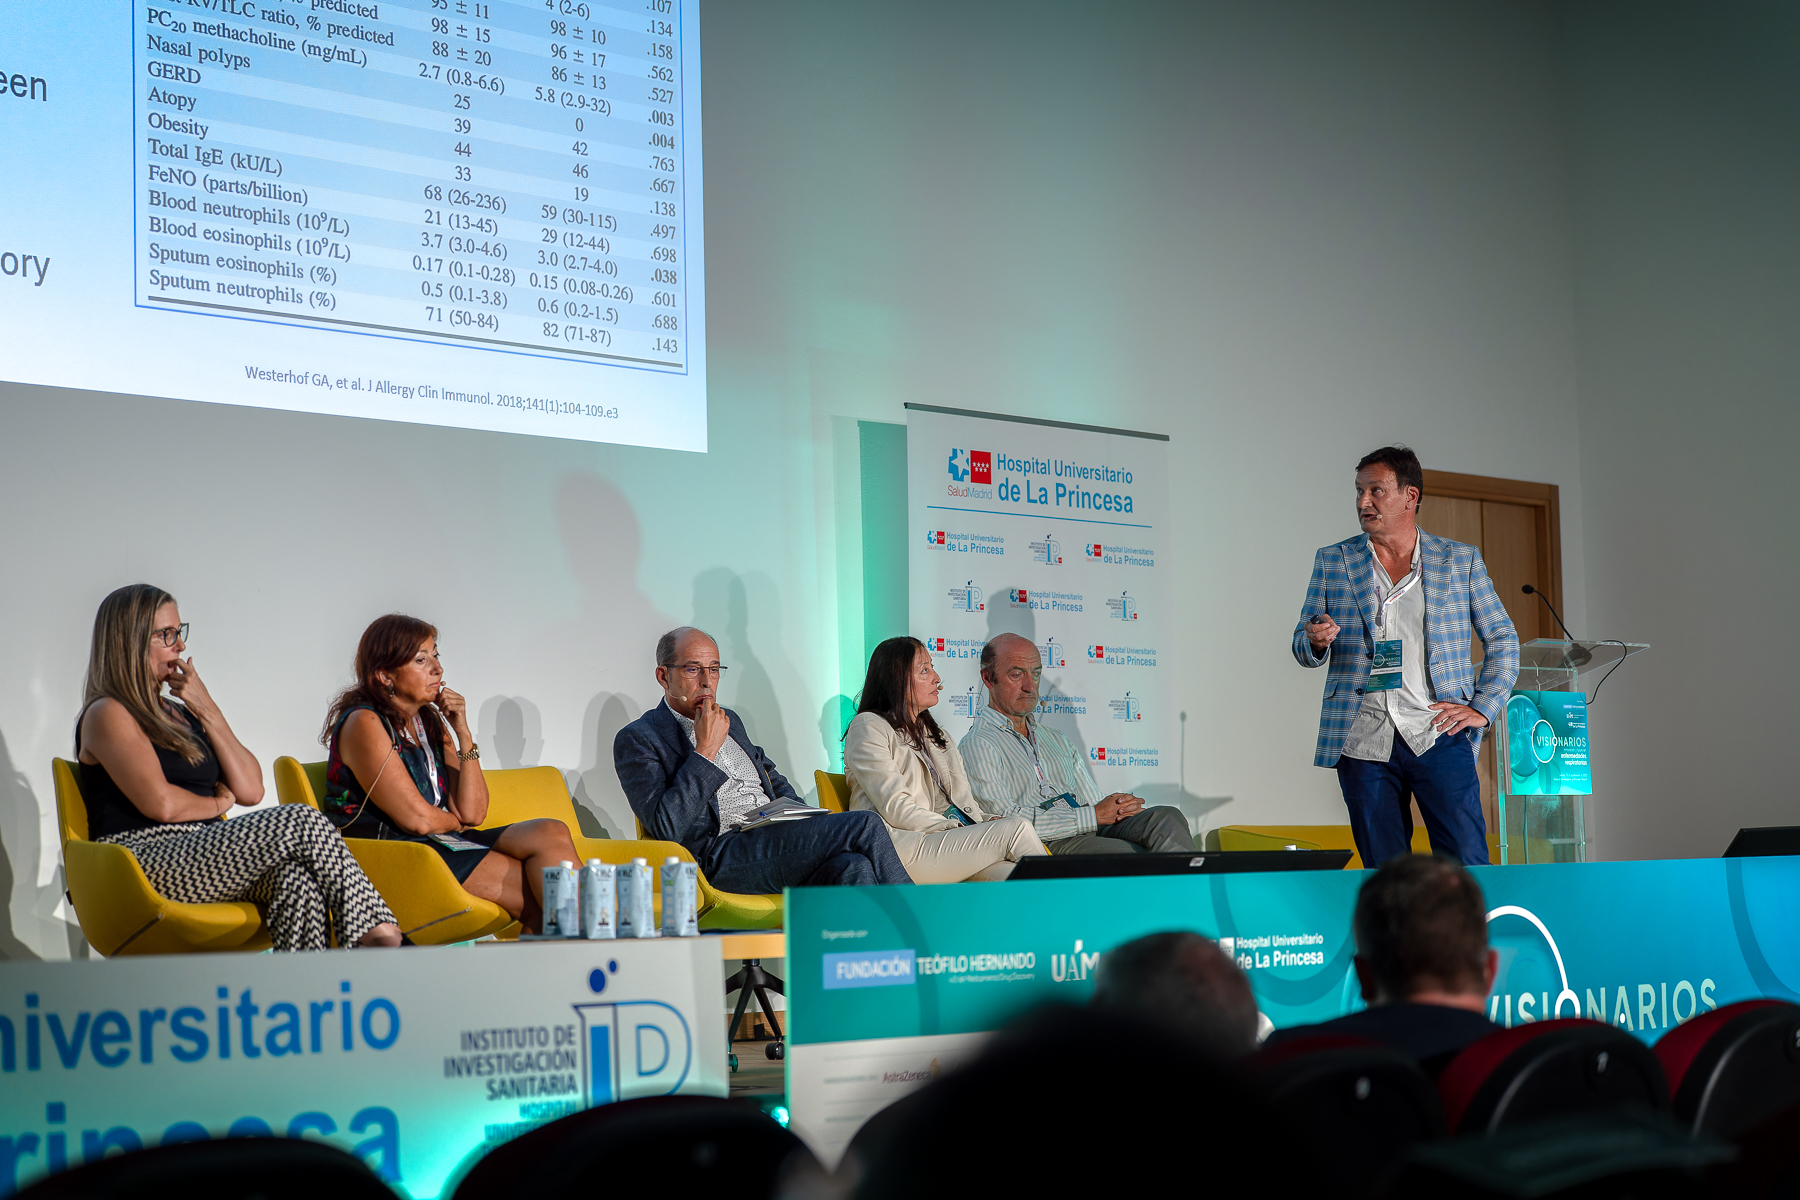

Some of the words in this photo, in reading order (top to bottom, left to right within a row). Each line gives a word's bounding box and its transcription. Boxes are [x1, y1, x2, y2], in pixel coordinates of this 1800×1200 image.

[311, 0, 379, 20] predicted
[475, 3, 489, 19] 11
[559, 0, 590, 21] (2-6)
[646, 0, 672, 14] .107
[261, 9, 300, 30] ratio,
[306, 15, 321, 31] %
[327, 23, 395, 47] predicted
[431, 17, 448, 35] 98
[476, 27, 490, 43] 15
[550, 19, 566, 36] 98
[592, 29, 606, 45] 10
[647, 20, 673, 37] .134
[146, 33, 192, 57] Nasal
[198, 48, 250, 71] polyps
[192, 21, 296, 52] methacholine
[301, 39, 367, 68] (mg/mL)
[432, 40, 449, 58] 88
[474, 50, 491, 66] 20
[647, 43, 673, 60] .158
[551, 43, 567, 60] 96
[592, 52, 606, 68] 17
[147, 61, 201, 84] GERD
[419, 62, 441, 80] 2.7
[446, 68, 505, 96] (0.8-6.6)
[551, 65, 568, 82] 86
[592, 75, 606, 90] 13
[647, 65, 674, 83] .562
[147, 86, 197, 112] Atopy
[454, 93, 470, 110] 25
[535, 86, 555, 103] 5.8
[561, 92, 611, 117] (2.9-32)
[648, 87, 674, 104] .527
[148, 112, 209, 140] Obesity
[454, 118, 471, 134] 39
[575, 117, 584, 132] 0
[648, 109, 674, 127] .003
[454, 141, 472, 157] 44
[572, 141, 588, 156] 42
[648, 132, 675, 150] .004
[147, 137, 189, 160] Total
[195, 145, 224, 167] IgE
[230, 152, 282, 178] (kU/L)
[649, 155, 675, 172] .763
[455, 165, 471, 182] 33
[572, 163, 589, 179] 46
[148, 164, 197, 187] FeNO
[203, 174, 308, 207] (parts/billion)
[575, 187, 589, 202] 19
[649, 177, 675, 194] .667
[148, 189, 197, 212] Blood
[203, 202, 291, 226] neutrophils
[424, 184, 442, 201] 68
[448, 188, 507, 215] (26-236)
[650, 201, 676, 217] .138
[424, 209, 441, 225] 21
[448, 213, 498, 237] (13-45)
[541, 204, 557, 220] 59
[562, 208, 617, 233] (30-115)
[148, 215, 197, 238] Blood
[203, 227, 292, 252] eosinophils
[541, 228, 558, 244] 29
[563, 232, 610, 255] (12-44)
[650, 223, 676, 240] .497
[421, 231, 443, 249] 3.7
[449, 236, 508, 262] (3.0-4.6)
[650, 246, 677, 263] .698
[0, 252, 51, 287] ory
[149, 242, 211, 266] Sputum
[216, 255, 304, 279] eosinophils
[310, 265, 337, 286] (%)
[412, 255, 443, 273] 0.17
[449, 260, 516, 287] (0.1-0.28)
[538, 250, 558, 267] 3.0
[563, 254, 618, 278] (2.7-4.0)
[651, 268, 677, 285] .038
[149, 269, 211, 292] Sputum
[216, 282, 303, 305] neutrophils
[309, 290, 336, 311] (%)
[421, 280, 443, 298] 0.5
[449, 285, 508, 310] (0.1-3.8)
[529, 272, 558, 290] 0.15
[563, 278, 633, 304] (0.08-0.26)
[651, 291, 676, 308] .601
[425, 306, 442, 322] 71
[449, 309, 499, 333] (50-84)
[538, 297, 559, 314] 0.6
[564, 301, 619, 325] (0.2-1.5)
[652, 314, 678, 331] .688
[543, 321, 559, 338] 82
[564, 325, 611, 347] (71-87)
[652, 337, 678, 353] .143
[245, 365, 310, 385] Westerhof
[312, 374, 333, 390] GA,
[336, 378, 348, 390] et
[351, 377, 365, 391] al.
[367, 379, 372, 392] J
[375, 380, 415, 399] Allergy
[417, 385, 438, 400] Clin
[442, 388, 494, 405] Immunol.
[497, 394, 619, 419] 2018;141(1):104-109.e3
[997, 453, 1050, 477] Hospital
[1054, 459, 1133, 484] Universitario
[947, 485, 992, 500] SaludMadrid
[998, 477, 1021, 502] de
[1026, 479, 1048, 505] La
[1056, 482, 1133, 513] Princesa
[946, 532, 969, 541] Hospital
[970, 533, 1004, 543] Universitario
[947, 541, 956, 551] de
[958, 542, 968, 552] La
[970, 543, 1004, 555] Princesa
[1103, 554, 1112, 564] de
[1114, 555, 1122, 564] La
[1124, 555, 1154, 567] Princesa
[1028, 590, 1050, 599] Hospital
[1029, 600, 1039, 609] de
[1040, 600, 1050, 610] La
[1052, 600, 1083, 612] Princesa
[946, 639, 969, 647] Hospital
[946, 648, 957, 658] de
[958, 648, 969, 658] La
[1105, 655, 1115, 665] de
[1116, 655, 1125, 665] La
[1126, 655, 1157, 667] Princesa
[1054, 703, 1087, 714] Princesa
[1536, 736, 1587, 748] VISIONARIOS
[1129, 756, 1159, 767] Princesa
[1236, 935, 1270, 951] Hospital
[1272, 933, 1324, 947] Universitario
[836, 954, 911, 980] FUNDACIÓN
[916, 953, 968, 975] TEÓFILO
[969, 952, 1036, 972] HERNANDO
[1255, 951, 1270, 968] La
[1273, 950, 1324, 967] Princesa
[460, 1025, 549, 1052] INSTITUTO
[553, 1024, 577, 1047] DE
[443, 1047, 577, 1079] INVESTIGACIÓN
[485, 1074, 579, 1101] SANITARIA
